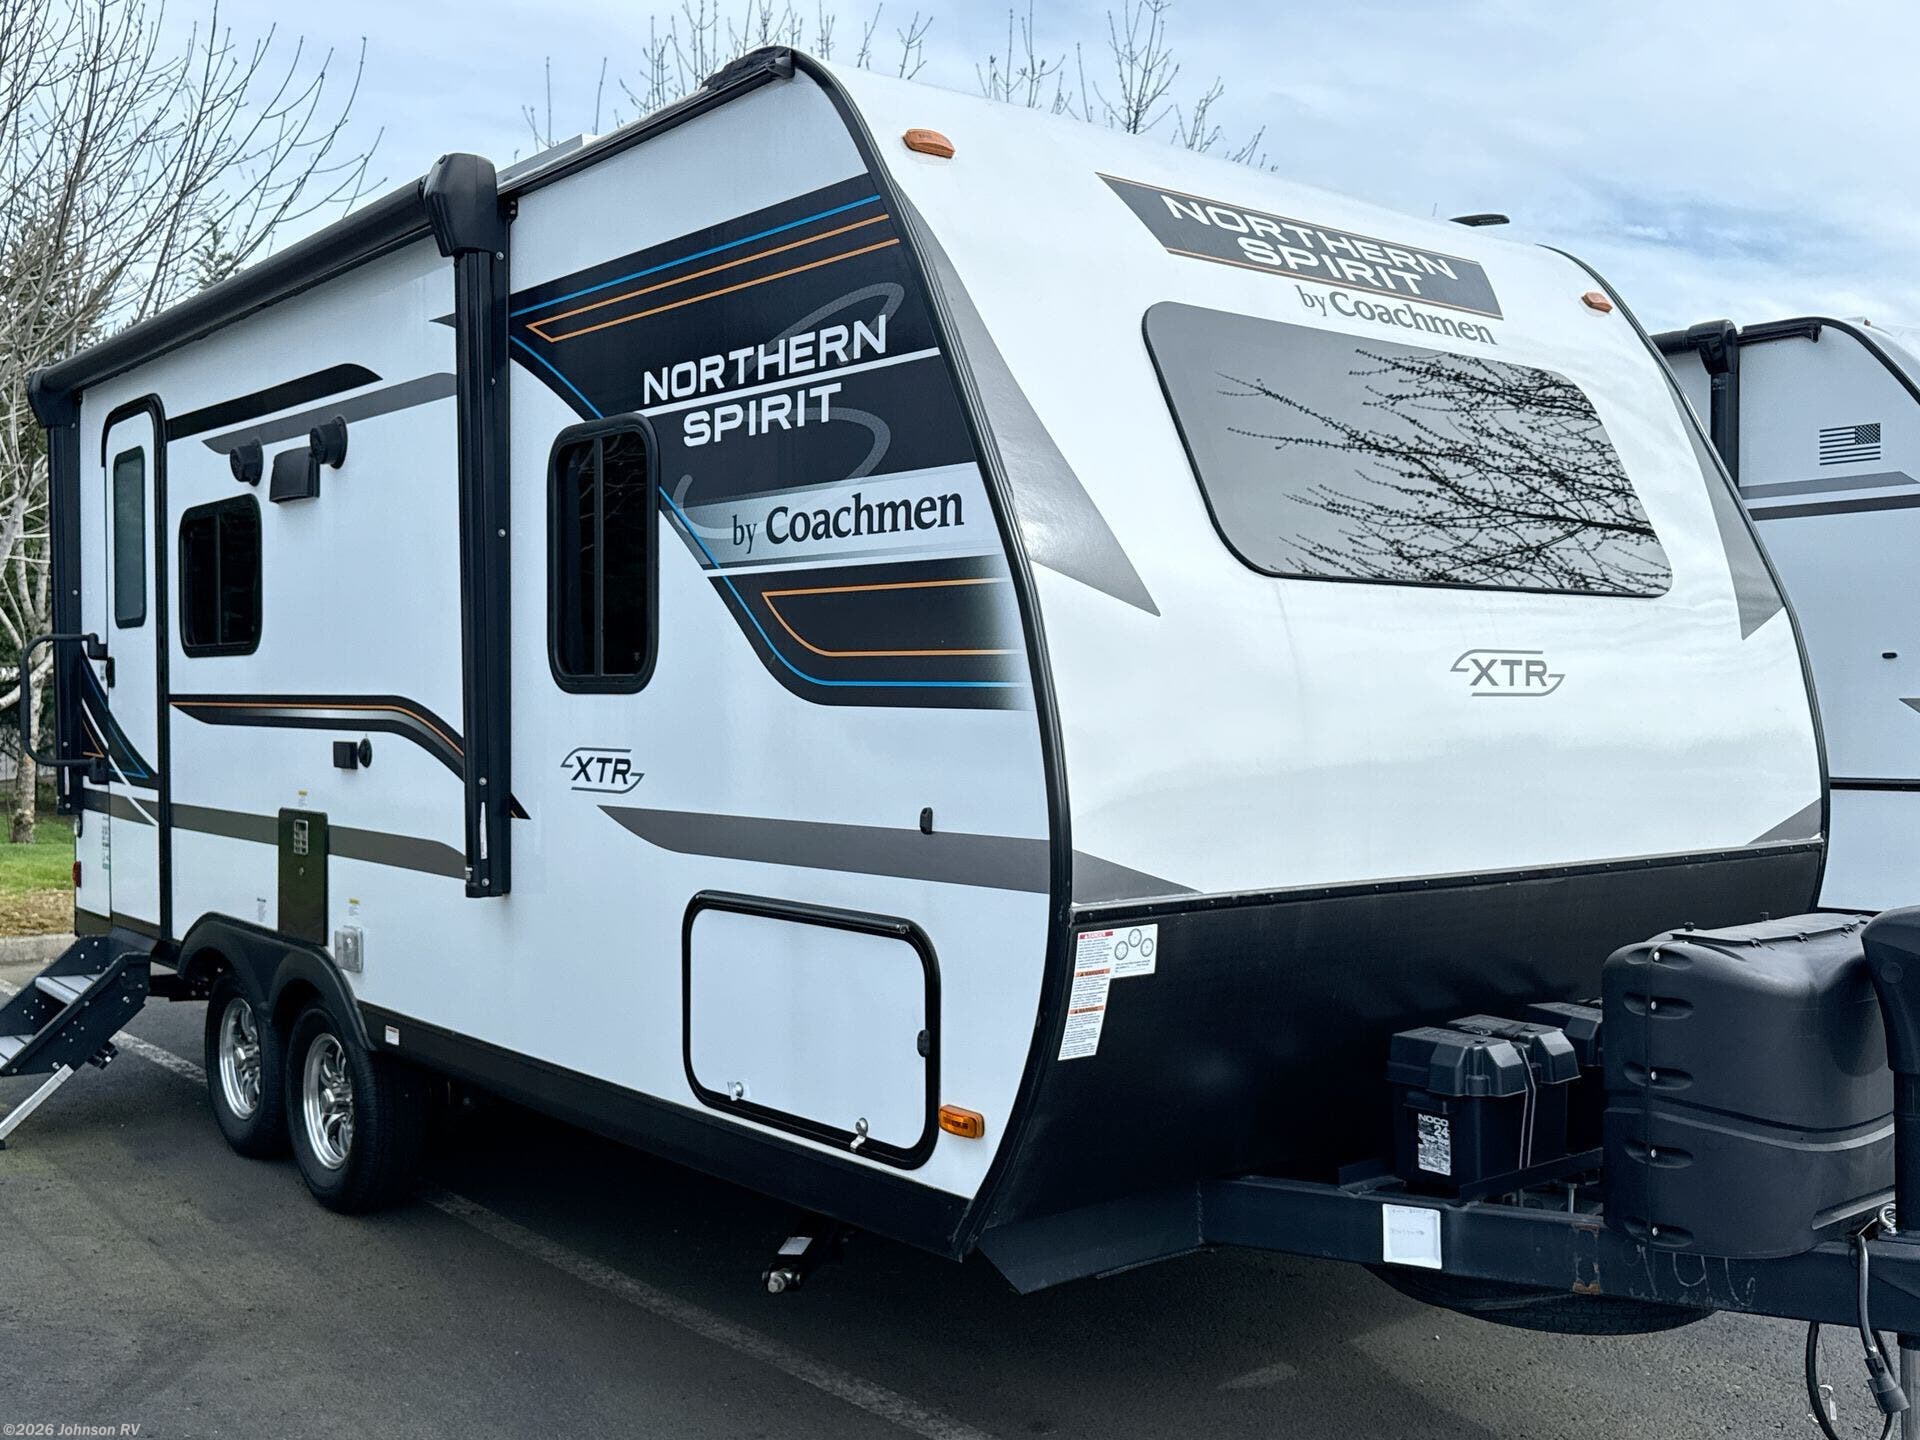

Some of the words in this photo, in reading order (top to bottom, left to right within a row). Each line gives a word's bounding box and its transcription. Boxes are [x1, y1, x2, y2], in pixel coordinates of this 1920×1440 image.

[1160, 194, 1458, 280] NORTHERN
[1236, 236, 1422, 295] SPIRIT
[1295, 285, 1328, 317] by
[1330, 291, 1498, 345] Coachmen
[643, 314, 887, 405] NORTHERN
[683, 382, 842, 447] SPIRIT
[732, 515, 758, 554] by
[765, 493, 965, 544] Coachmen
[1469, 658, 1548, 687] XTR
[571, 755, 632, 785] XTR
[1417, 1113, 1449, 1127] NOCO
[1433, 1124, 1450, 1138] 24
